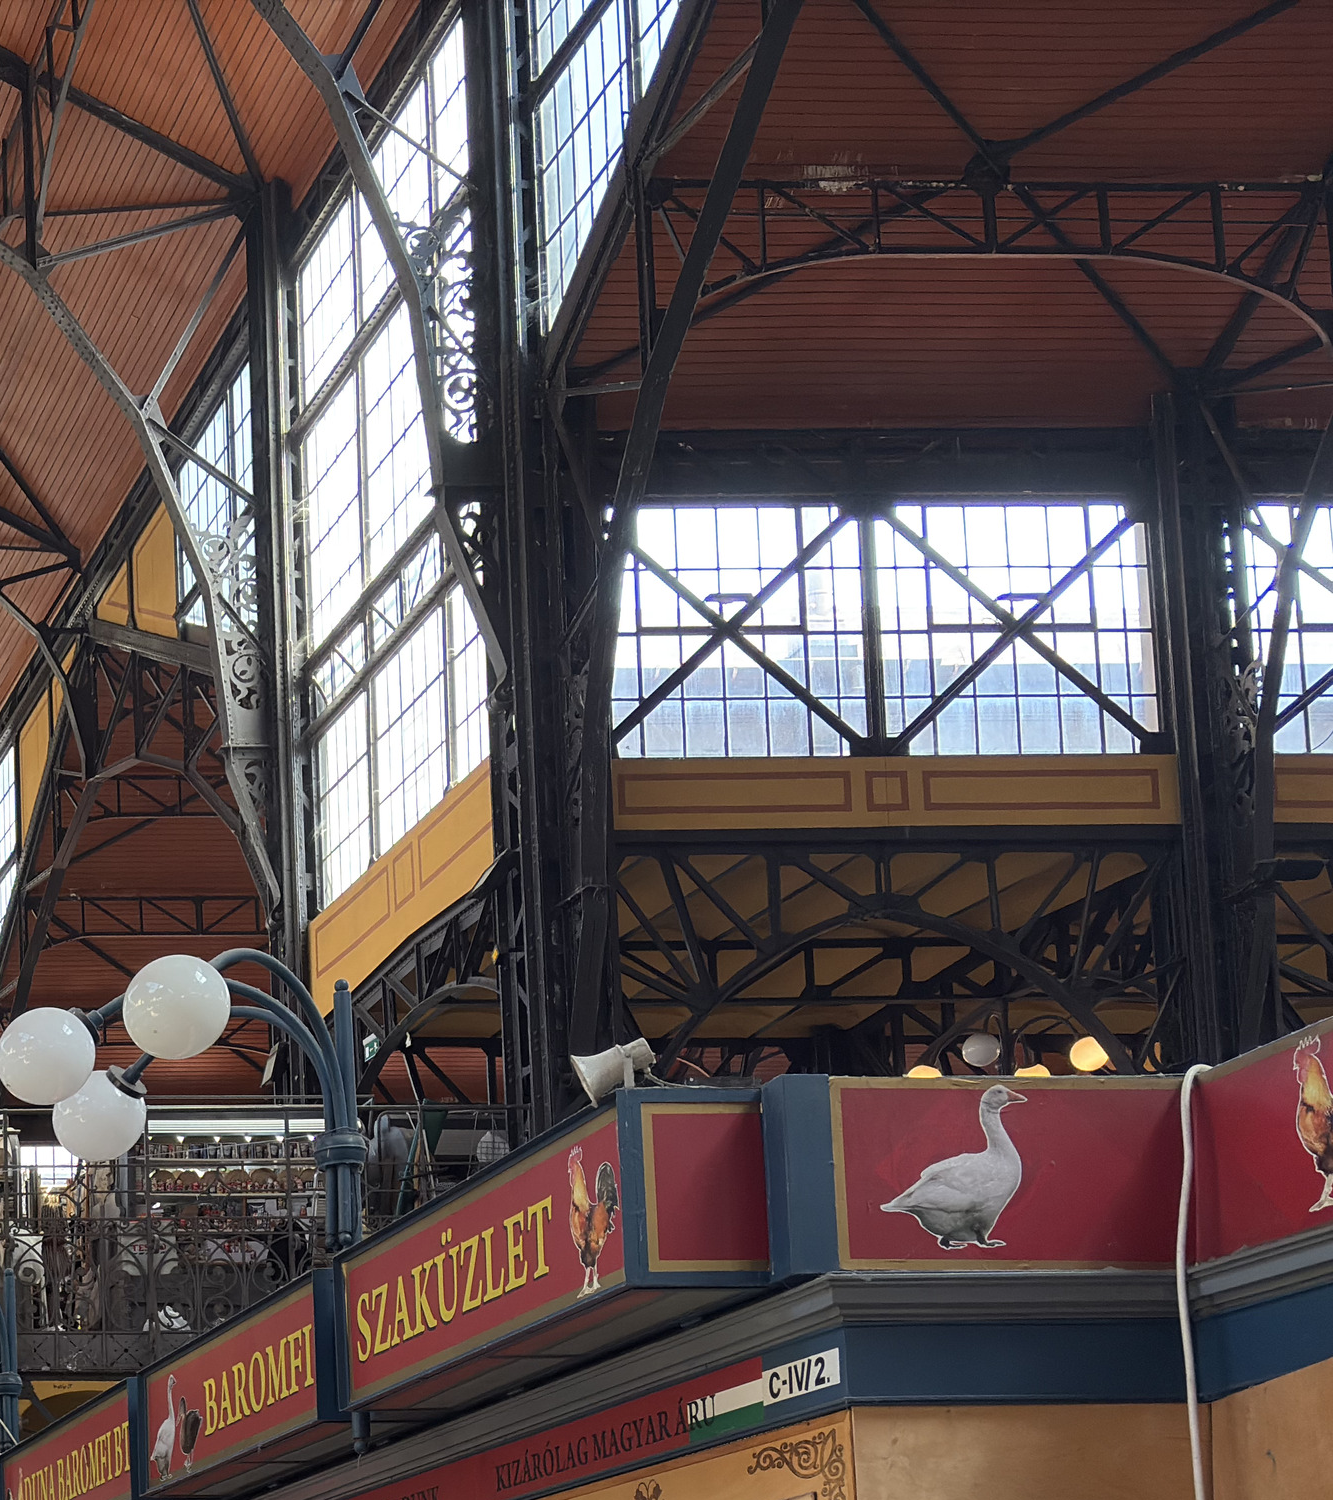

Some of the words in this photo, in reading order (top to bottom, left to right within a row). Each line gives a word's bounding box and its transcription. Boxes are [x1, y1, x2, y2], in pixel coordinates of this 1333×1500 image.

[132, 1243, 168, 1255] TESO
[355, 1194, 552, 1362] SZAKÜZLET
[203, 1324, 315, 1437] BAROMFI
[495, 1436, 589, 1493] KIZÁRÓLAG
[591, 1410, 674, 1460] MAGYAR
[674, 1395, 718, 1435] ÁRU
